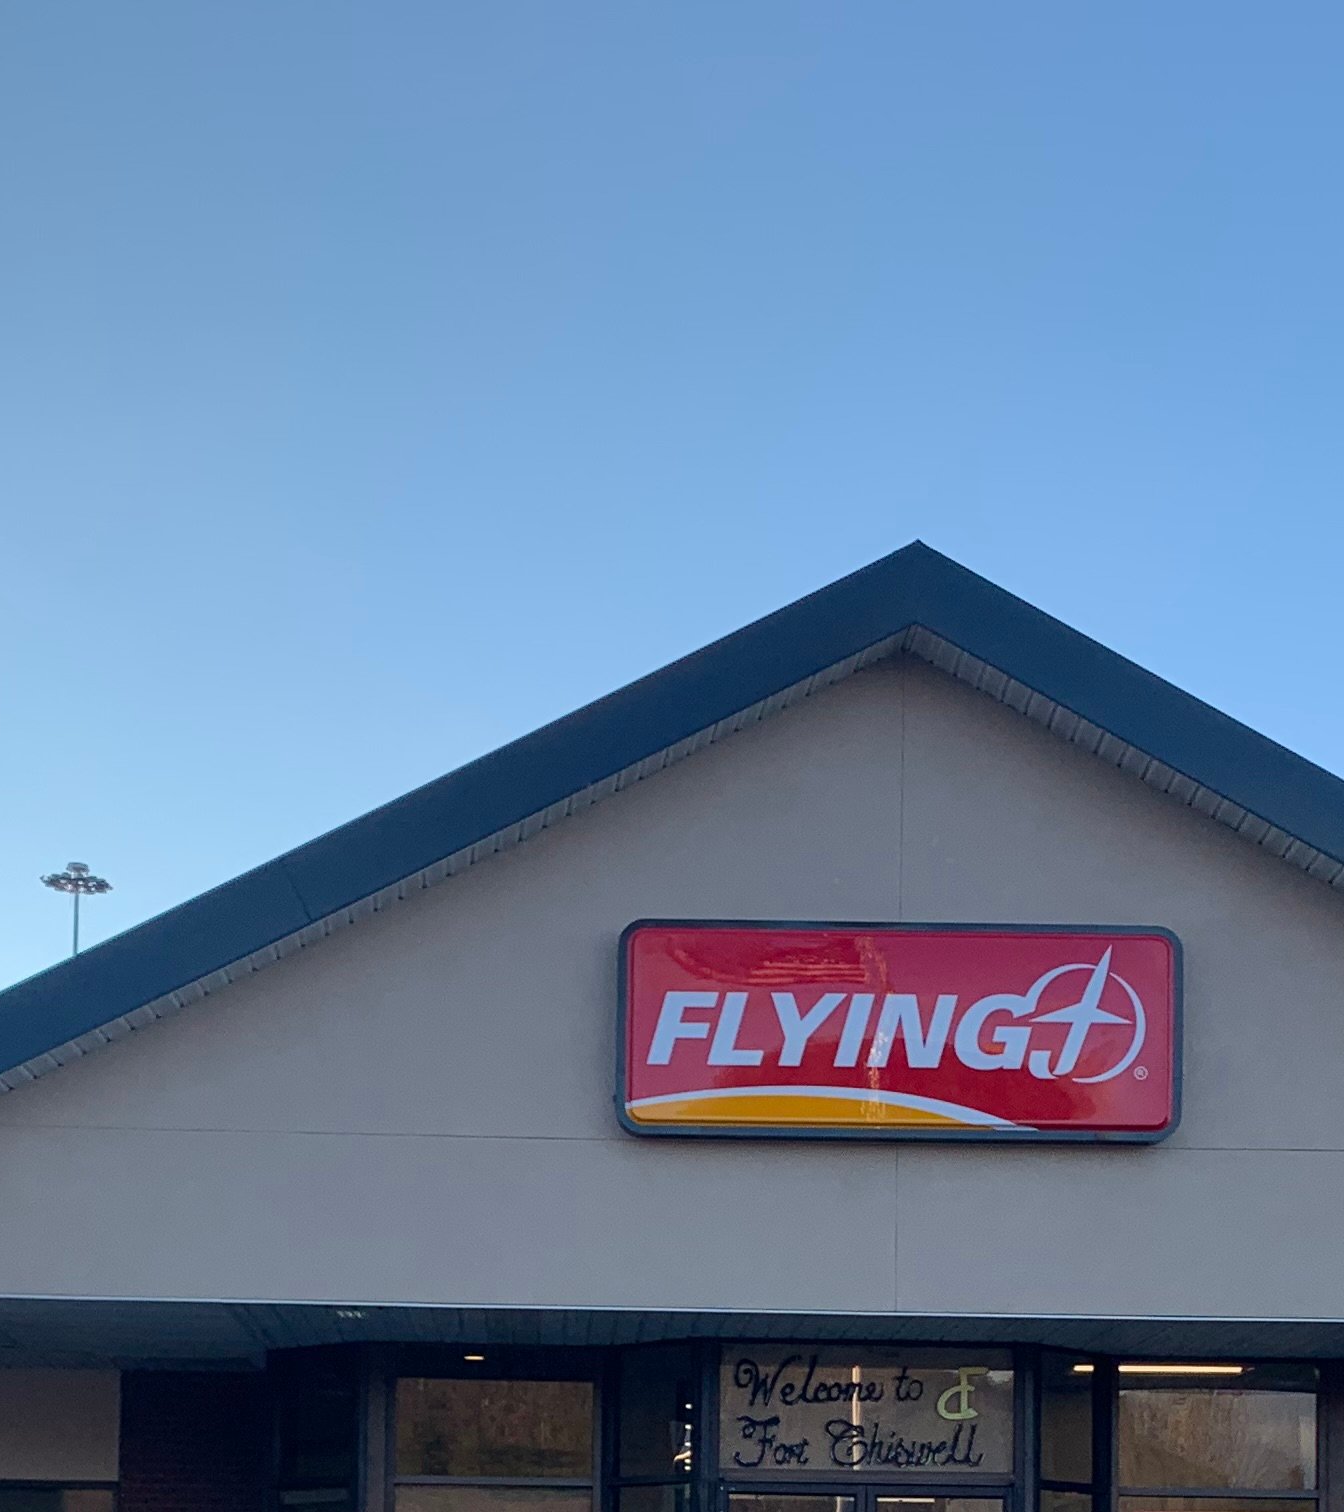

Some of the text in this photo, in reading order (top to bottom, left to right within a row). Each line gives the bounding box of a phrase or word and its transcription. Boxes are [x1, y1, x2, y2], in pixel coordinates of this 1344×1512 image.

[734, 1355, 884, 1406] Welcome
[894, 1367, 924, 1402] to
[733, 1416, 985, 1468] Fort Chiswell
